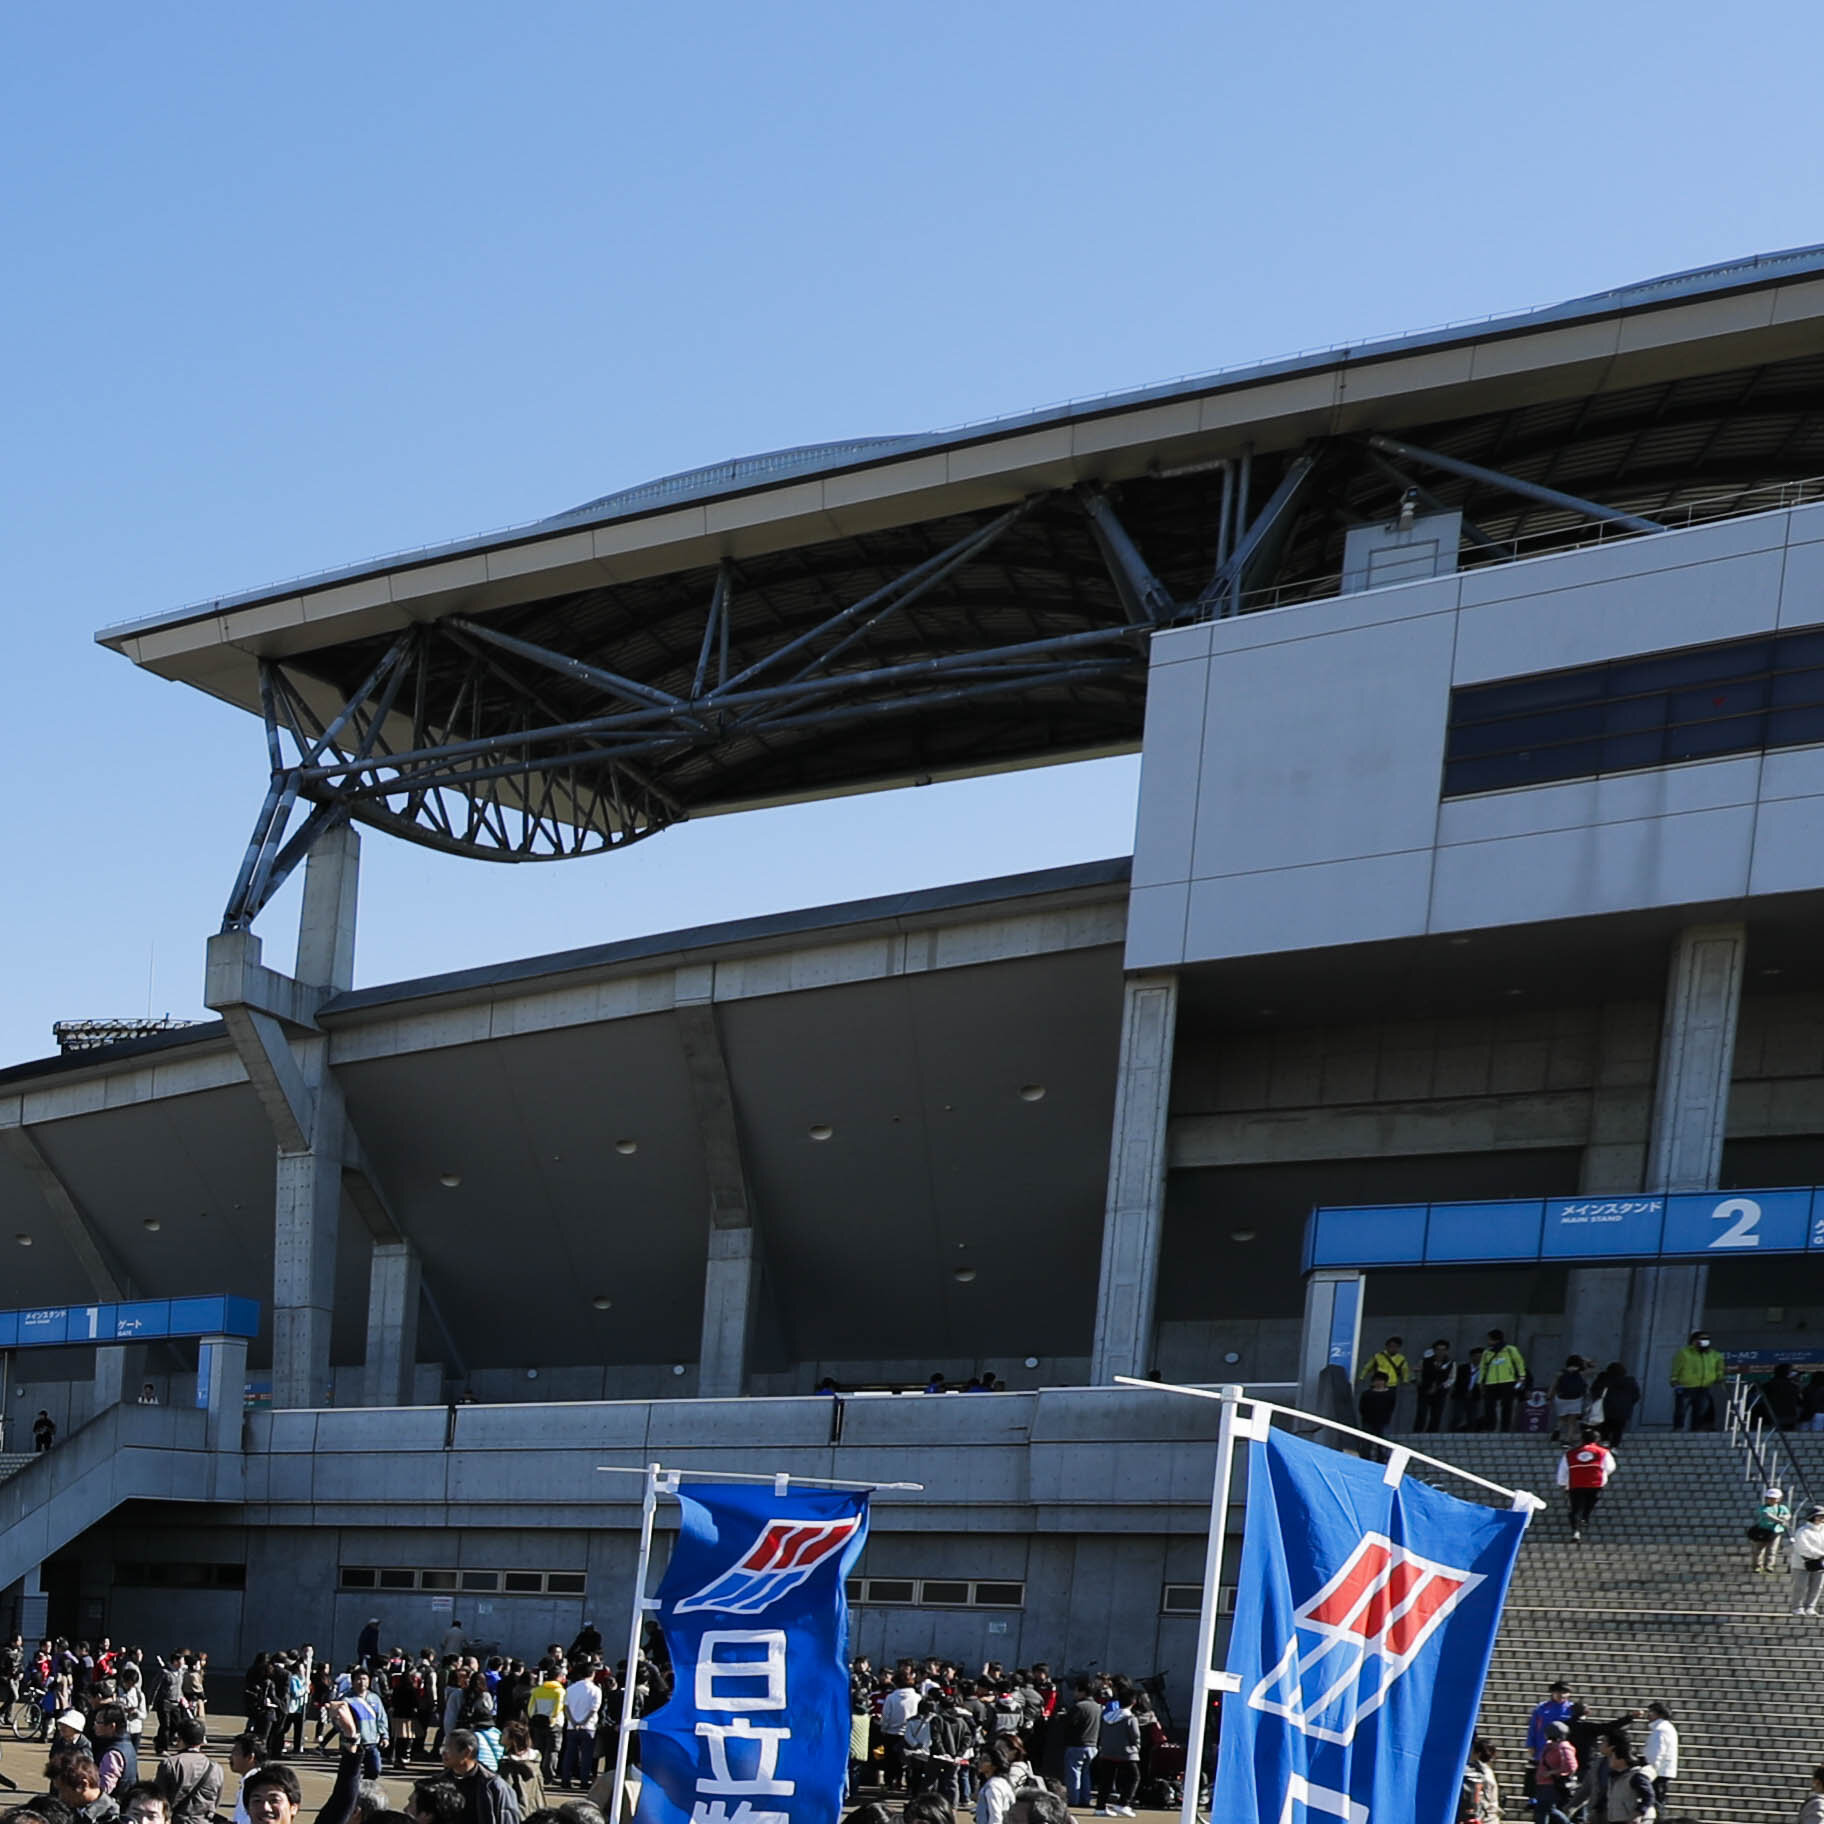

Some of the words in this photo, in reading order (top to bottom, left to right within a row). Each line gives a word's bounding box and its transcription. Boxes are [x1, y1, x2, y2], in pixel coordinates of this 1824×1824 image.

[1561, 1201, 1662, 1216] メインスタンド
[1708, 1198, 1761, 1248] 2
[86, 1308, 98, 1339] 1
